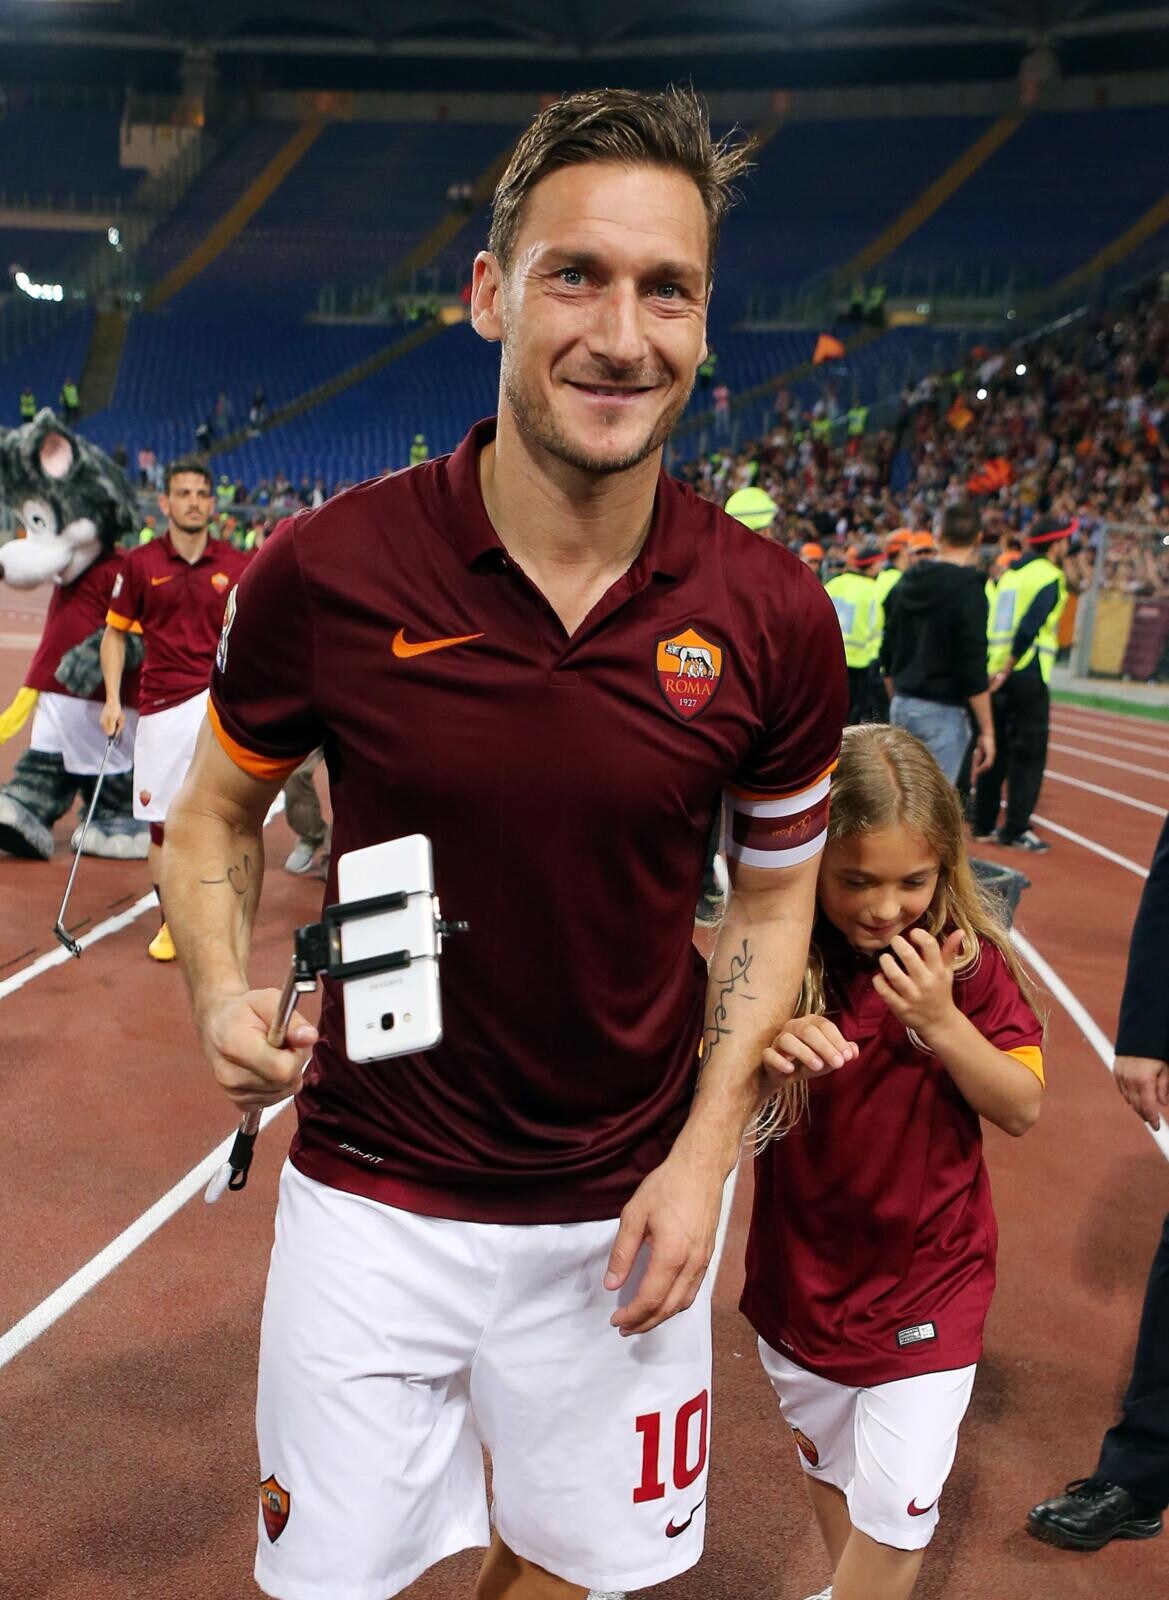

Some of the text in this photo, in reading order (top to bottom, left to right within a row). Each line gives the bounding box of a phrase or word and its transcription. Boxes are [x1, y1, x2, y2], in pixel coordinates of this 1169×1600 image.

[665, 679, 711, 696] ROMA
[679, 698, 697, 707] 1927
[338, 1143, 384, 1164] DRI-FIT
[633, 1388, 708, 1504] 10
